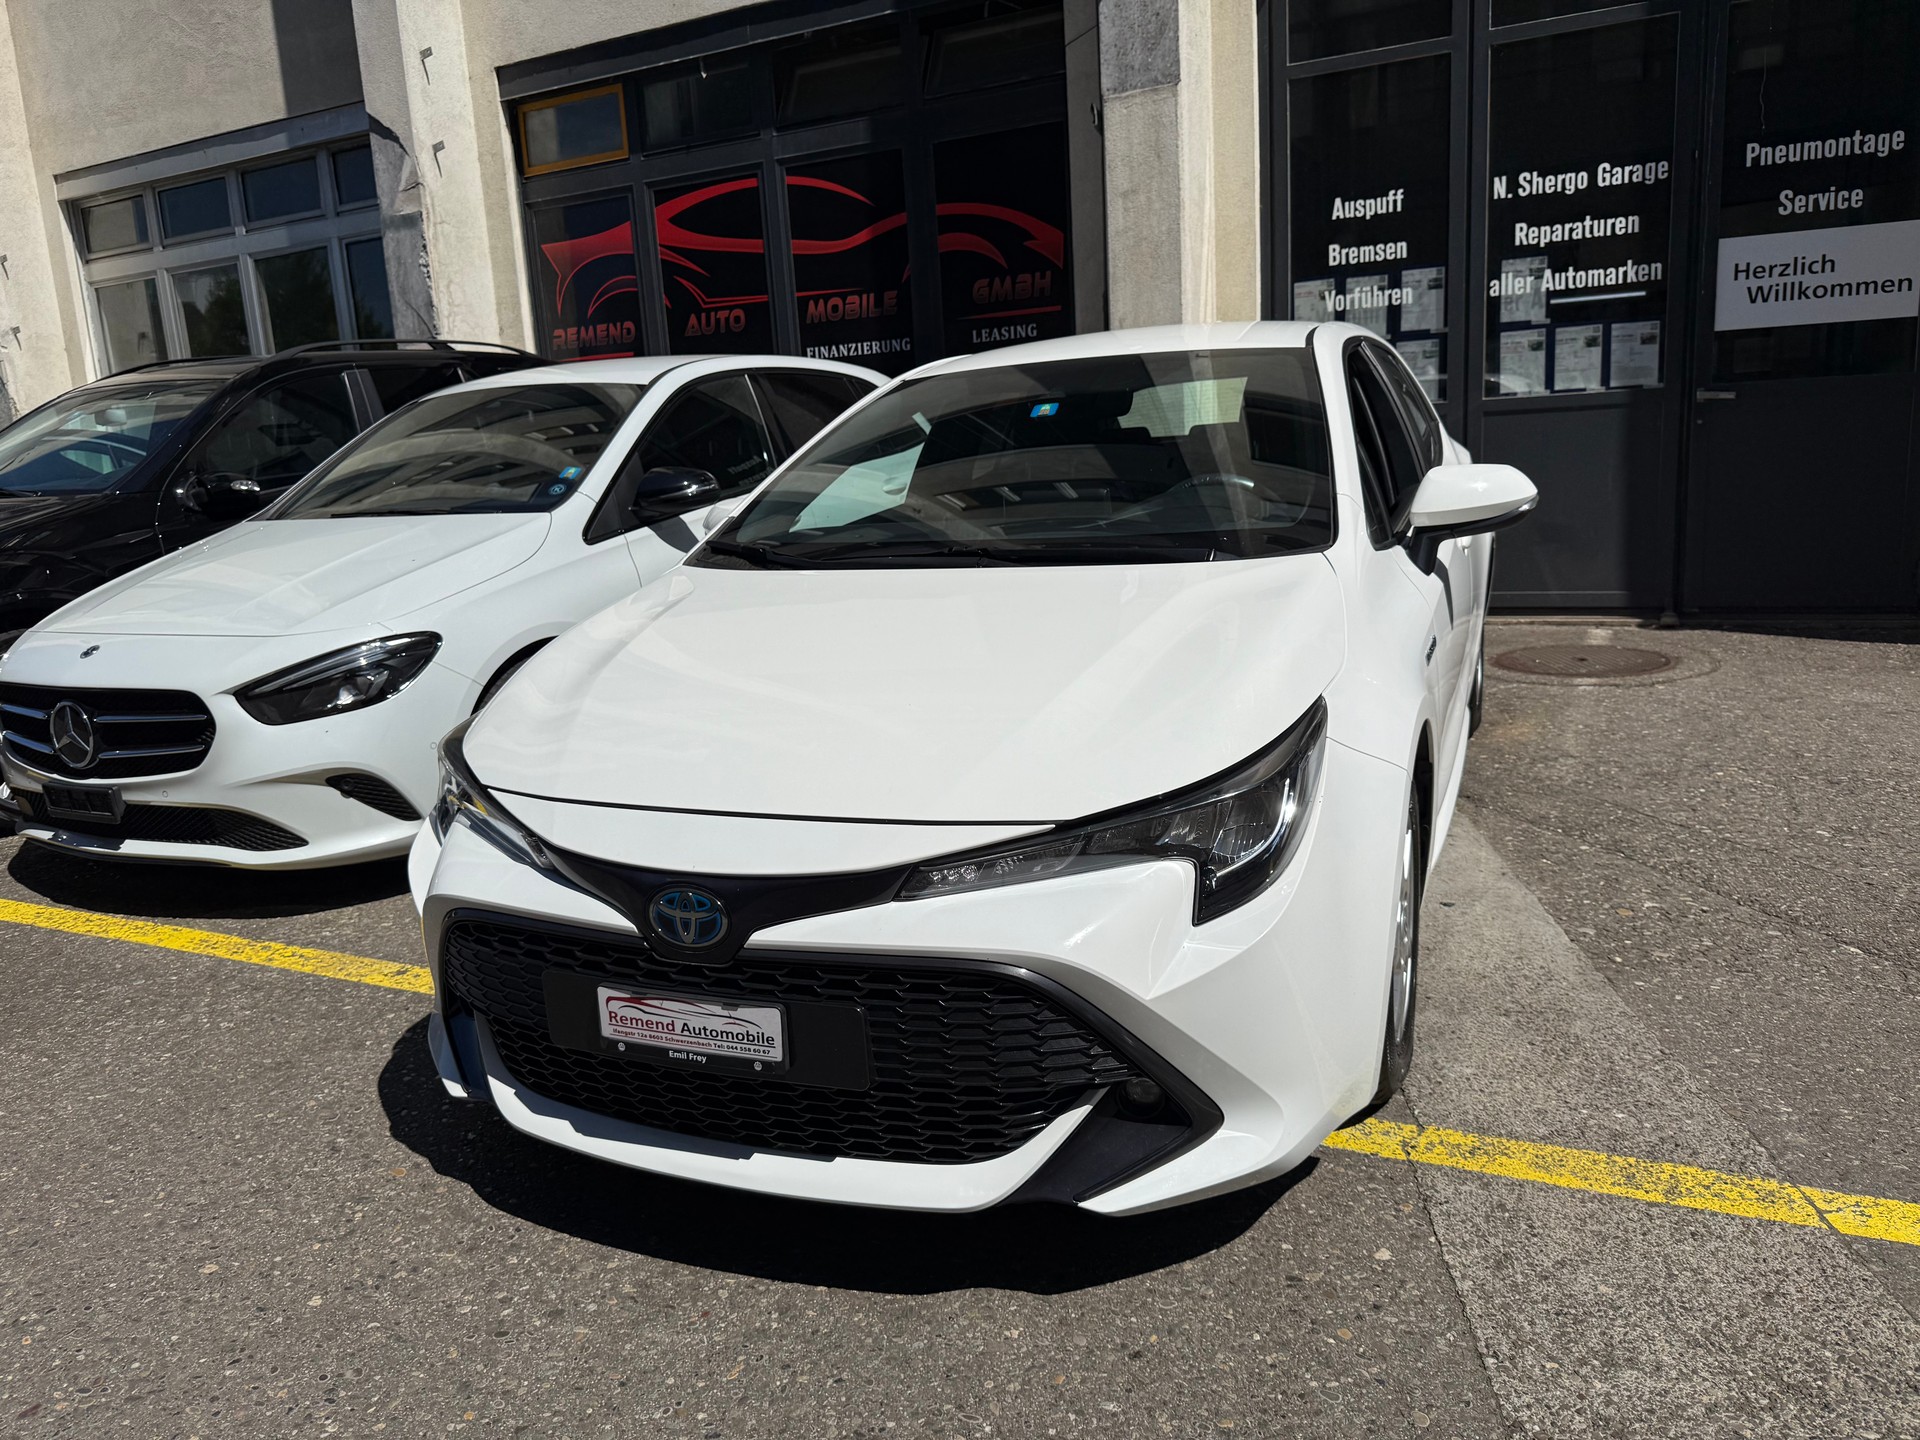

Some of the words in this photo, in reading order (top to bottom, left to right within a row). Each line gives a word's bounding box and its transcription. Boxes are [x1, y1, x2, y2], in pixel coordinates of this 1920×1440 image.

[1745, 129, 1906, 168] Pneumontage
[1492, 175, 1514, 200] N.
[1517, 171, 1589, 195] Shergo
[1597, 160, 1669, 188] Garage
[1331, 188, 1405, 221] Auspuff
[1777, 186, 1864, 216] Service
[1513, 215, 1641, 248] Reparaturen
[1328, 240, 1408, 267] Bremsen
[1733, 253, 1836, 281] Herzlich
[1489, 272, 1536, 297] aller
[1540, 259, 1664, 293] Automarken
[1746, 276, 1914, 305] Willkommen
[552, 320, 636, 350] REMEND
[684, 308, 747, 338] AUTO
[806, 290, 899, 325] MOBILE
[972, 270, 1052, 304] GMBH
[1323, 284, 1414, 313] Vorführen
[805, 337, 912, 360] FINANZIERUNG
[972, 323, 1038, 344] LEASING
[608, 1010, 676, 1033] Remend
[680, 1021, 776, 1046] Automobile
[668, 1050, 688, 1060] Emil
[688, 1052, 708, 1064] Frey
